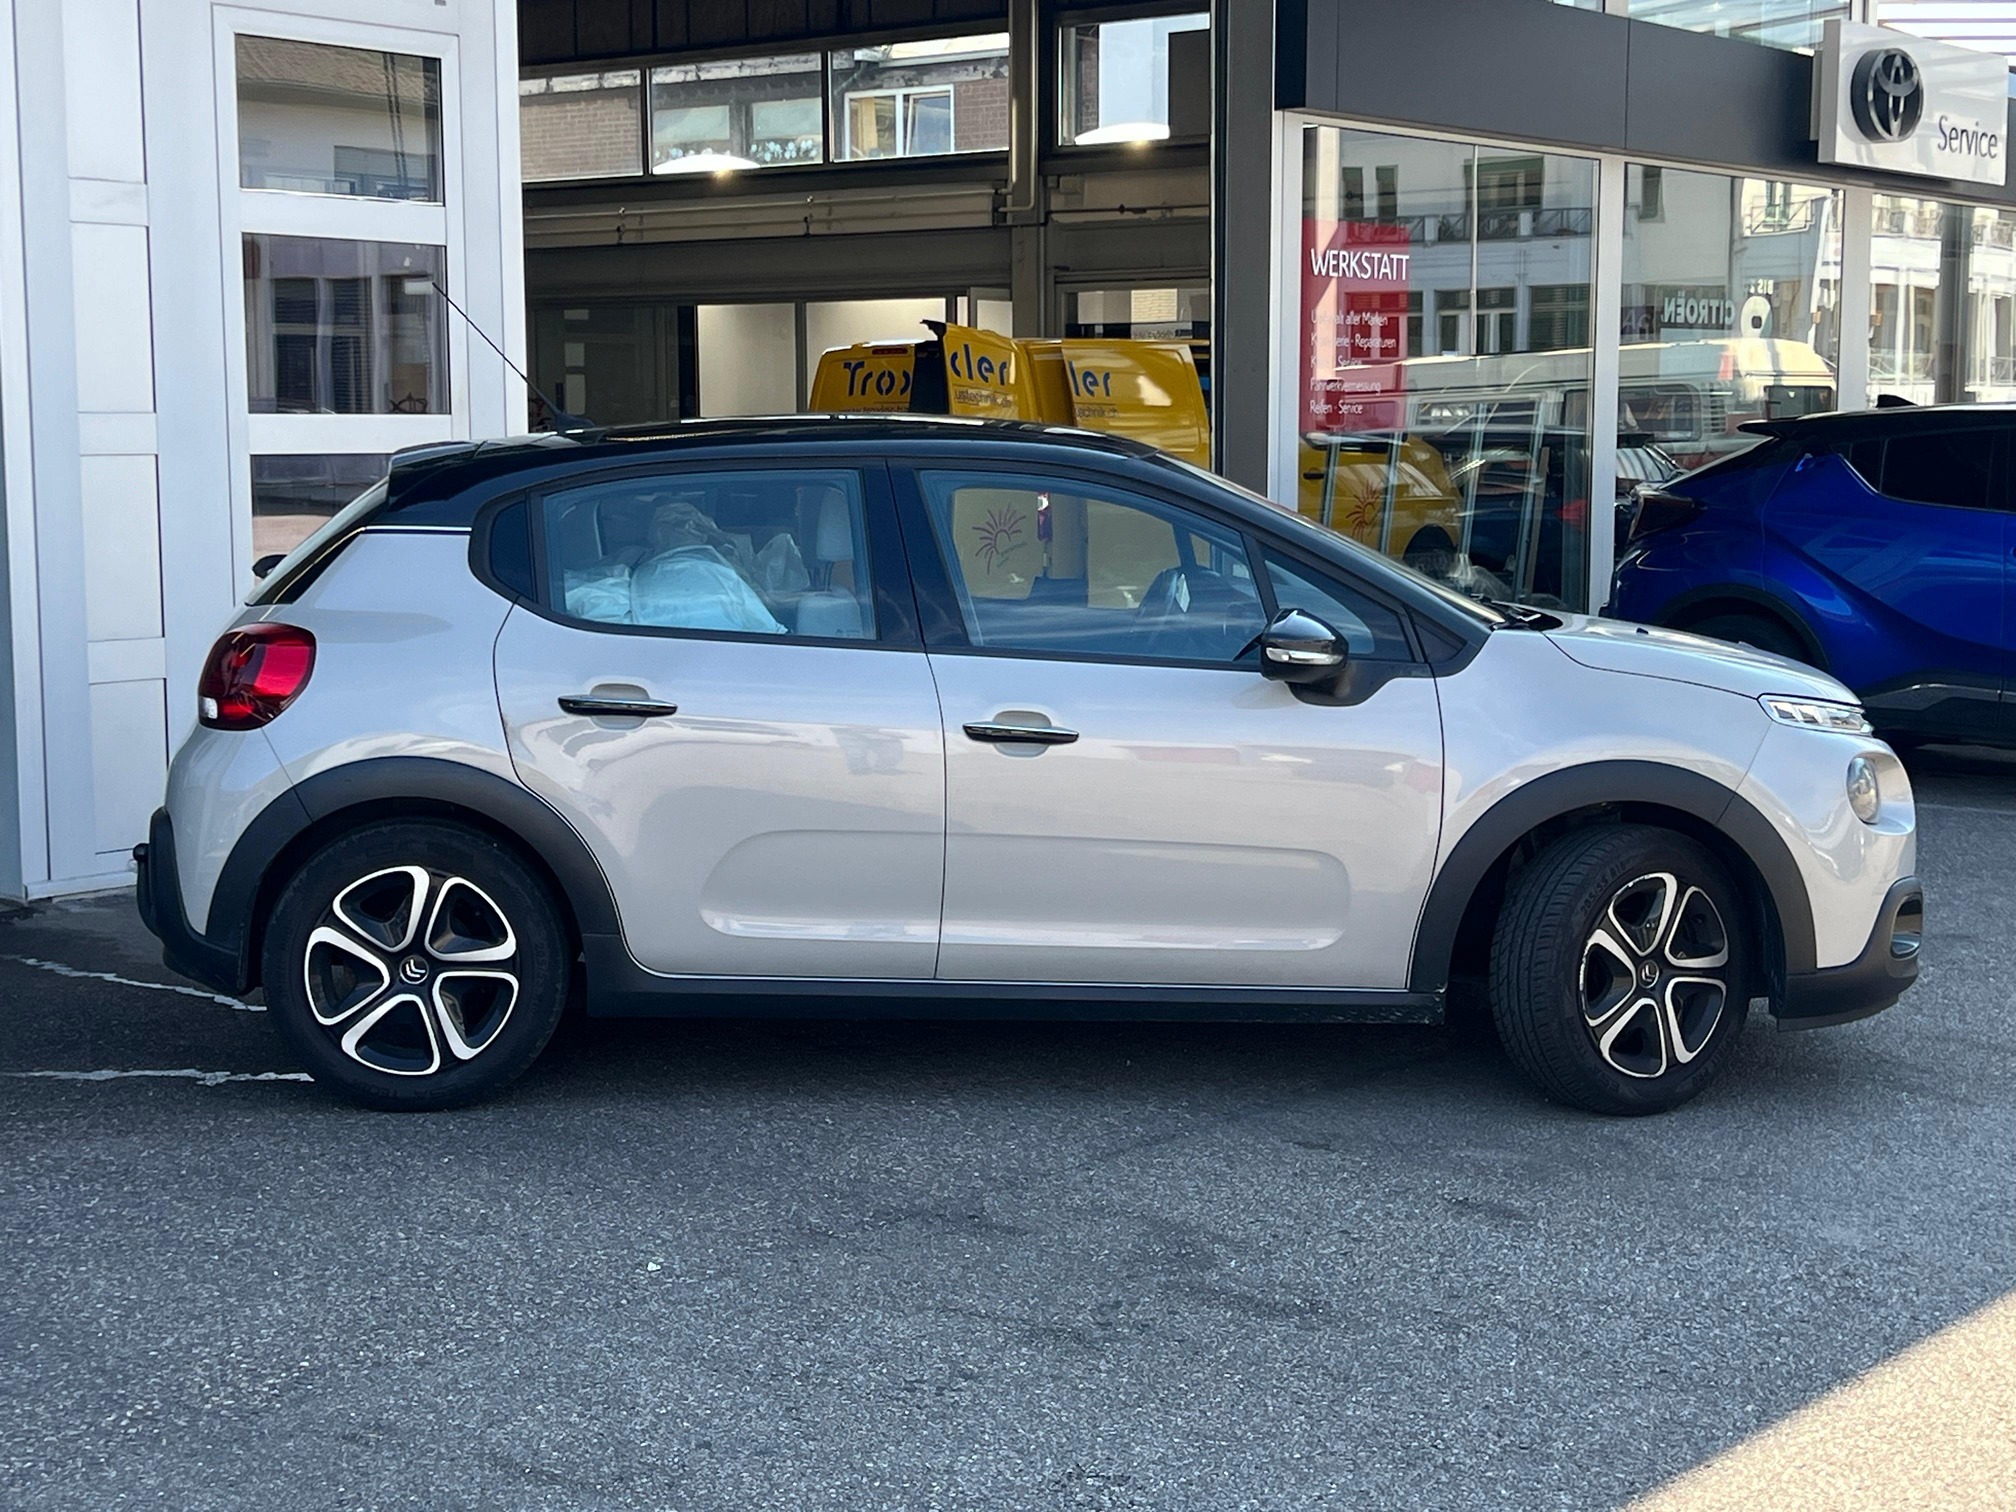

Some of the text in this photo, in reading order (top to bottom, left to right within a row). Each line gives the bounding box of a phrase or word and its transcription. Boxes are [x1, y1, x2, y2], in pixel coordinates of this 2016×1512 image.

[1938, 115, 1999, 159] Service
[1310, 248, 1410, 281] WERKSTATT
[1310, 398, 1363, 414] Reifen Service
